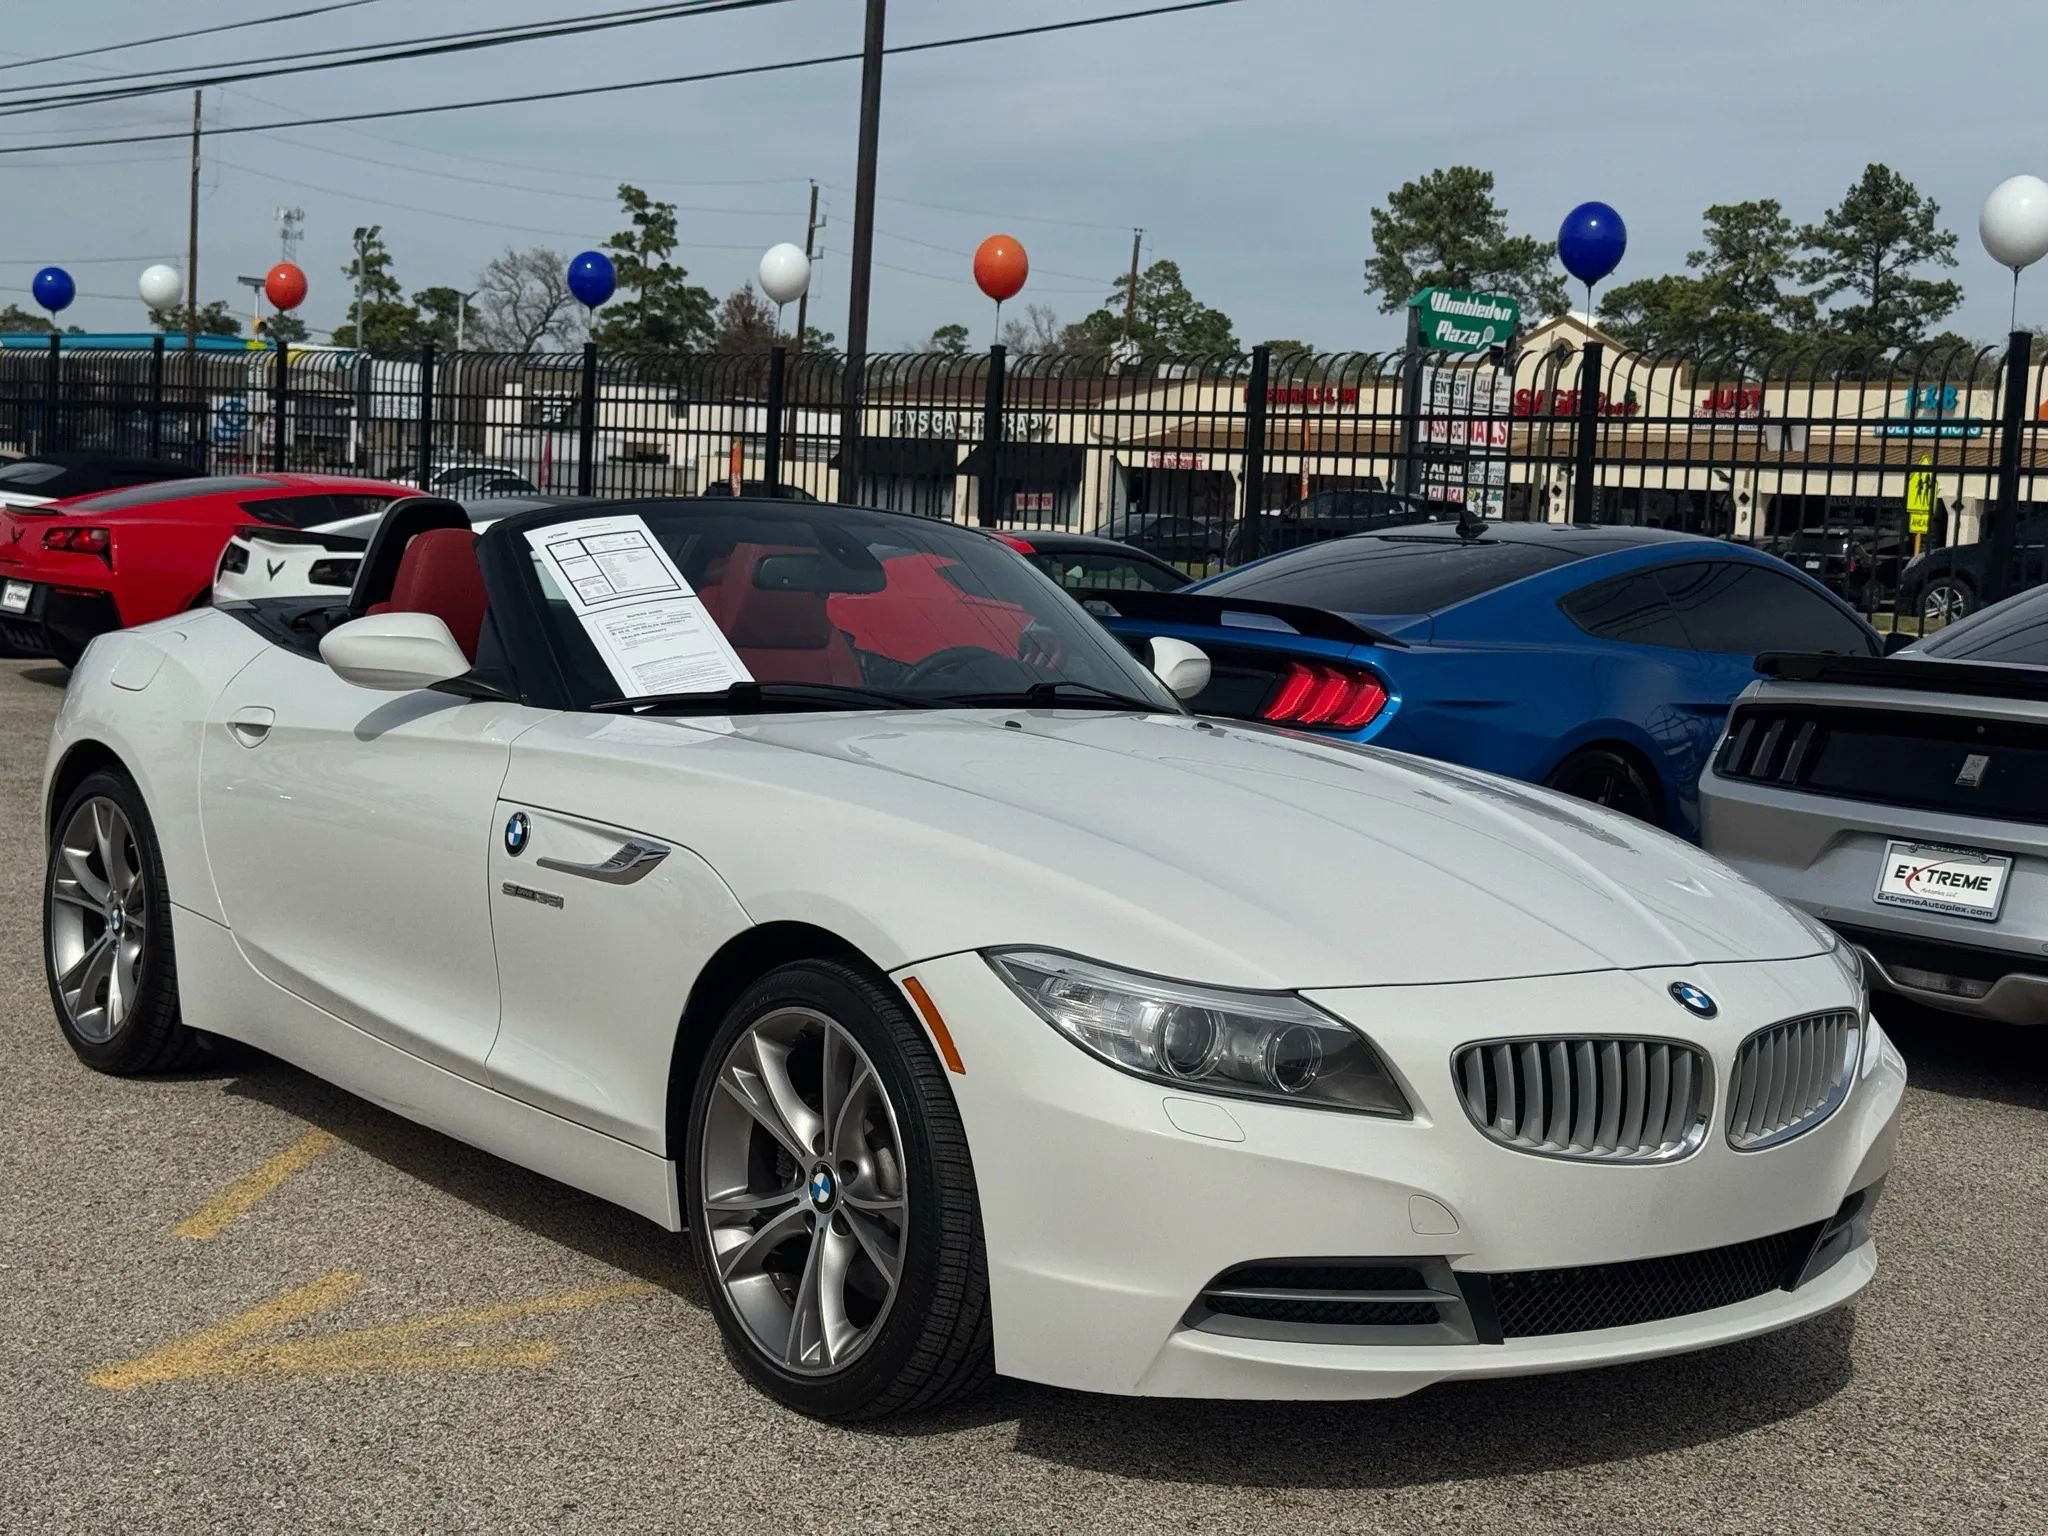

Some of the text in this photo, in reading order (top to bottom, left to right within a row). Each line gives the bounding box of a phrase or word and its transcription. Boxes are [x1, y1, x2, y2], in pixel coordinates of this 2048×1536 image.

[1430, 291, 1512, 322] Wimbledon
[1436, 319, 1480, 345] Plaza
[1431, 381, 1465, 397] ENTST
[1702, 388, 1762, 410] JUST
[892, 411, 1053, 438] PHYSCA TRAP
[1423, 420, 1462, 440] MASSGE
[1468, 420, 1506, 445] ALS
[1913, 425, 1980, 435] SERVICS
[1431, 487, 1462, 500] CLIICA
[1911, 519, 1927, 529] AHEA
[1894, 864, 1992, 892] EXTREME
[1877, 893, 1993, 918] ExtremeAutoplex.com
